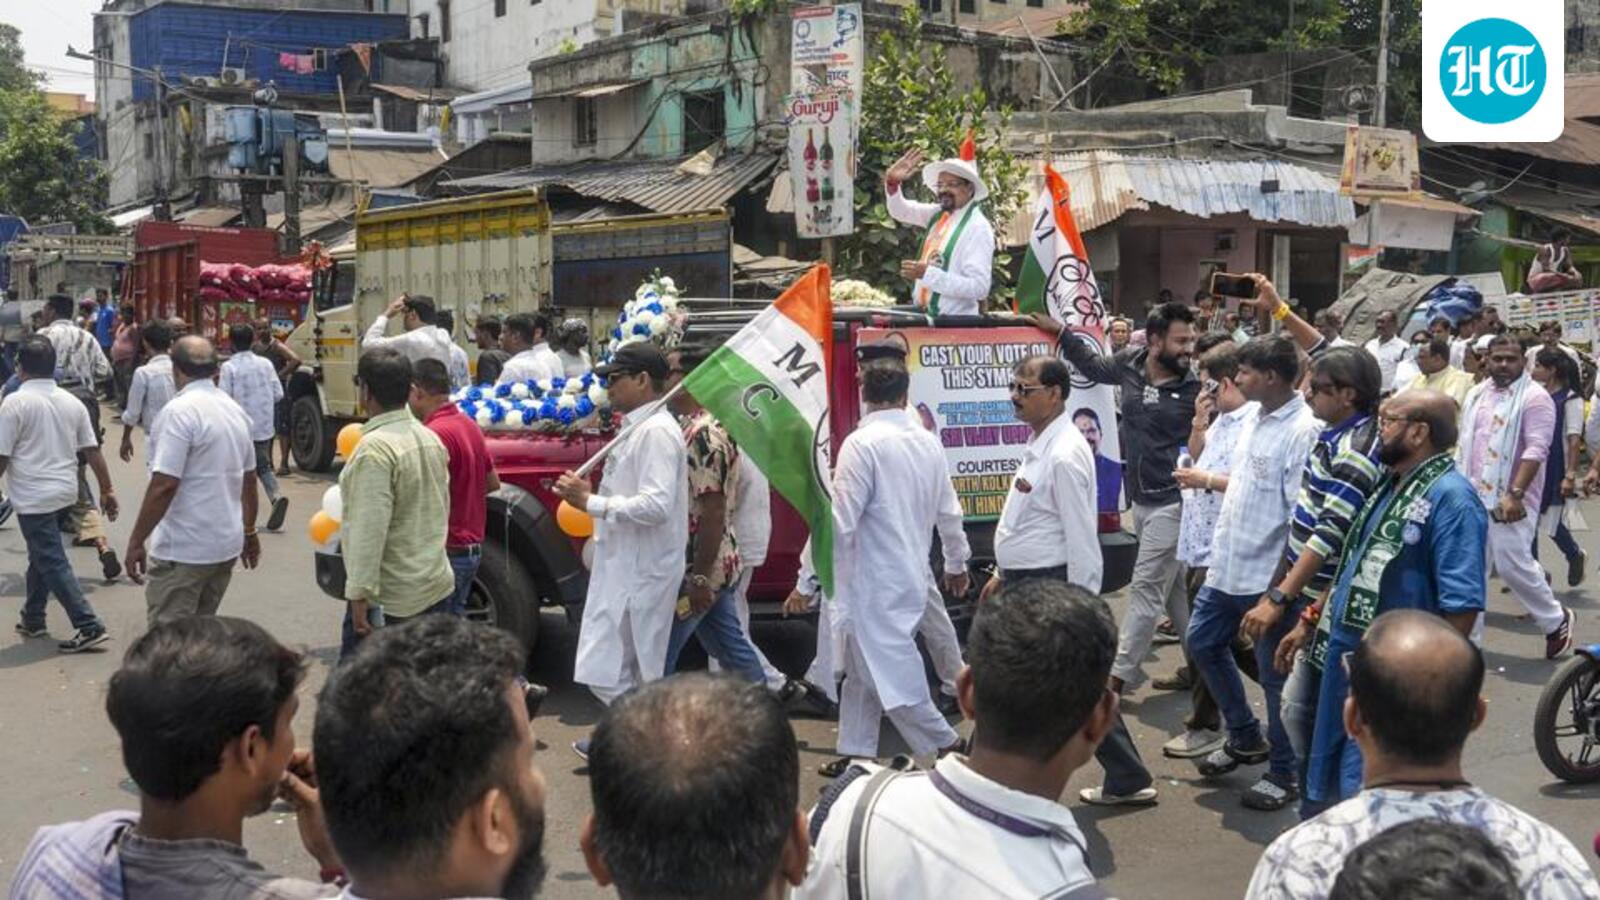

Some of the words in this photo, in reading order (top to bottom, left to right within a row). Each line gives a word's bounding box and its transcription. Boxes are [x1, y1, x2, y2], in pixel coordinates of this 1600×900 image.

[792, 95, 839, 124] Guruji
[773, 341, 821, 389] M
[921, 345, 955, 366] CAST
[957, 344, 993, 365] YOUR
[995, 344, 1028, 365] VOTE
[942, 368, 974, 389] THIS
[976, 367, 1015, 388] SYMB
[742, 383, 780, 420] C
[951, 475, 980, 493] ORTH
